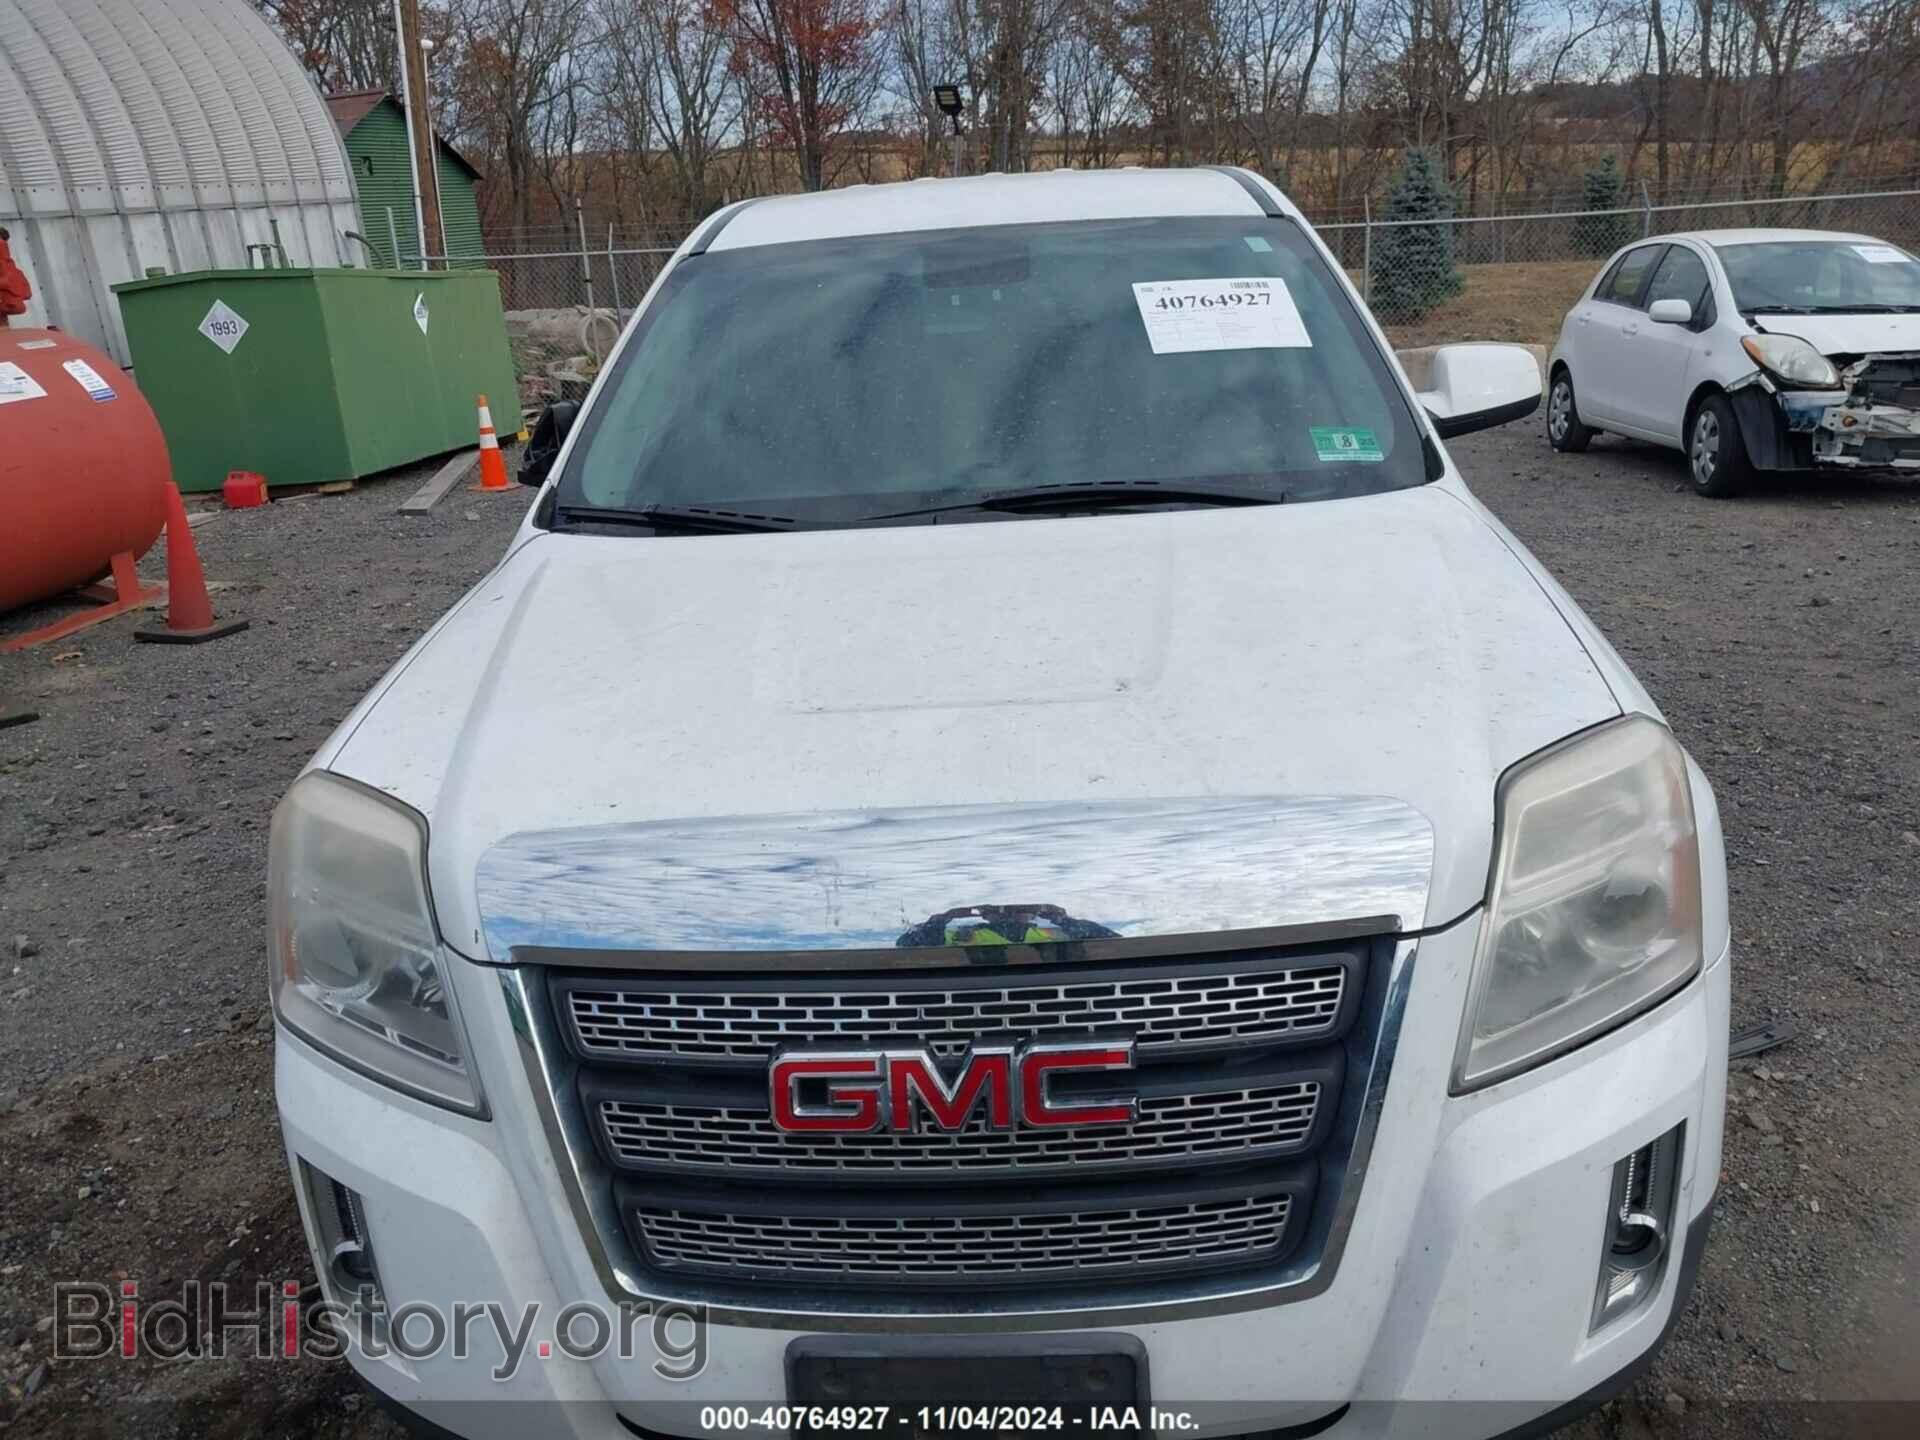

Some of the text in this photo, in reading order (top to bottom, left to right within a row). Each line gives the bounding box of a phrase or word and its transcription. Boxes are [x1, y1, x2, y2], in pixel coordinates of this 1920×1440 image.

[1155, 293, 1271, 310] 40764927
[210, 320, 238, 336] 1993
[769, 1041, 1138, 1134] GMC
